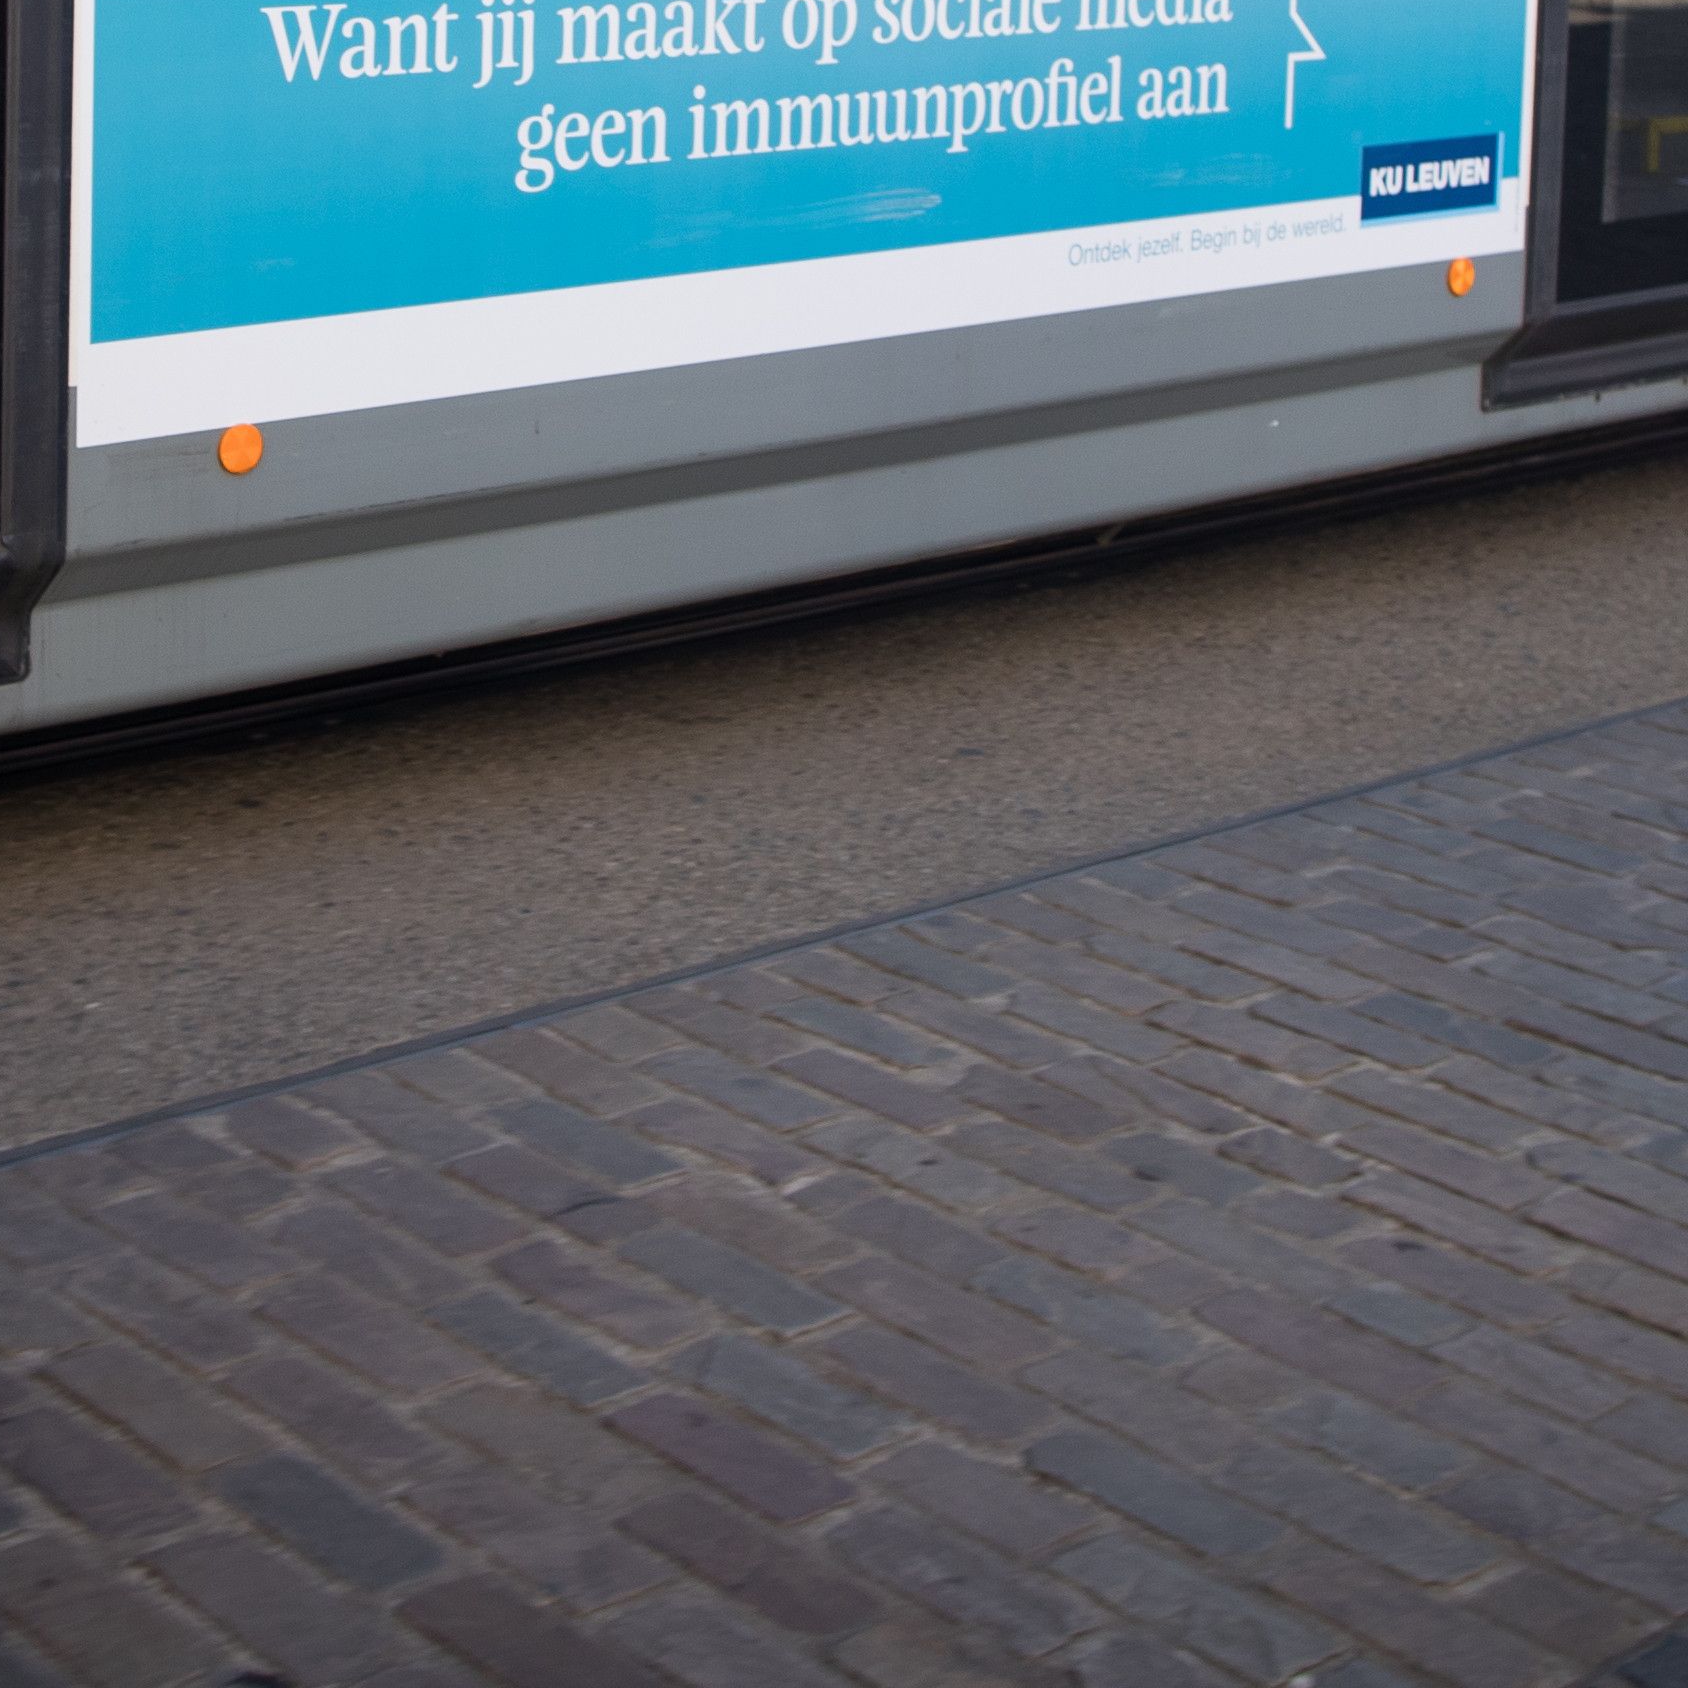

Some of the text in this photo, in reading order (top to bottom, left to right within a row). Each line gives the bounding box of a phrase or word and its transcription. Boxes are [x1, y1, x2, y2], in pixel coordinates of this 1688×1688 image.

[260, 3, 460, 83] Want
[514, 55, 1230, 193] geen immuunprofiel aan
[1369, 156, 1490, 197] KU LEUVEN
[1068, 214, 1347, 267] Ontdek jezelf. Begin bij de wereld.
